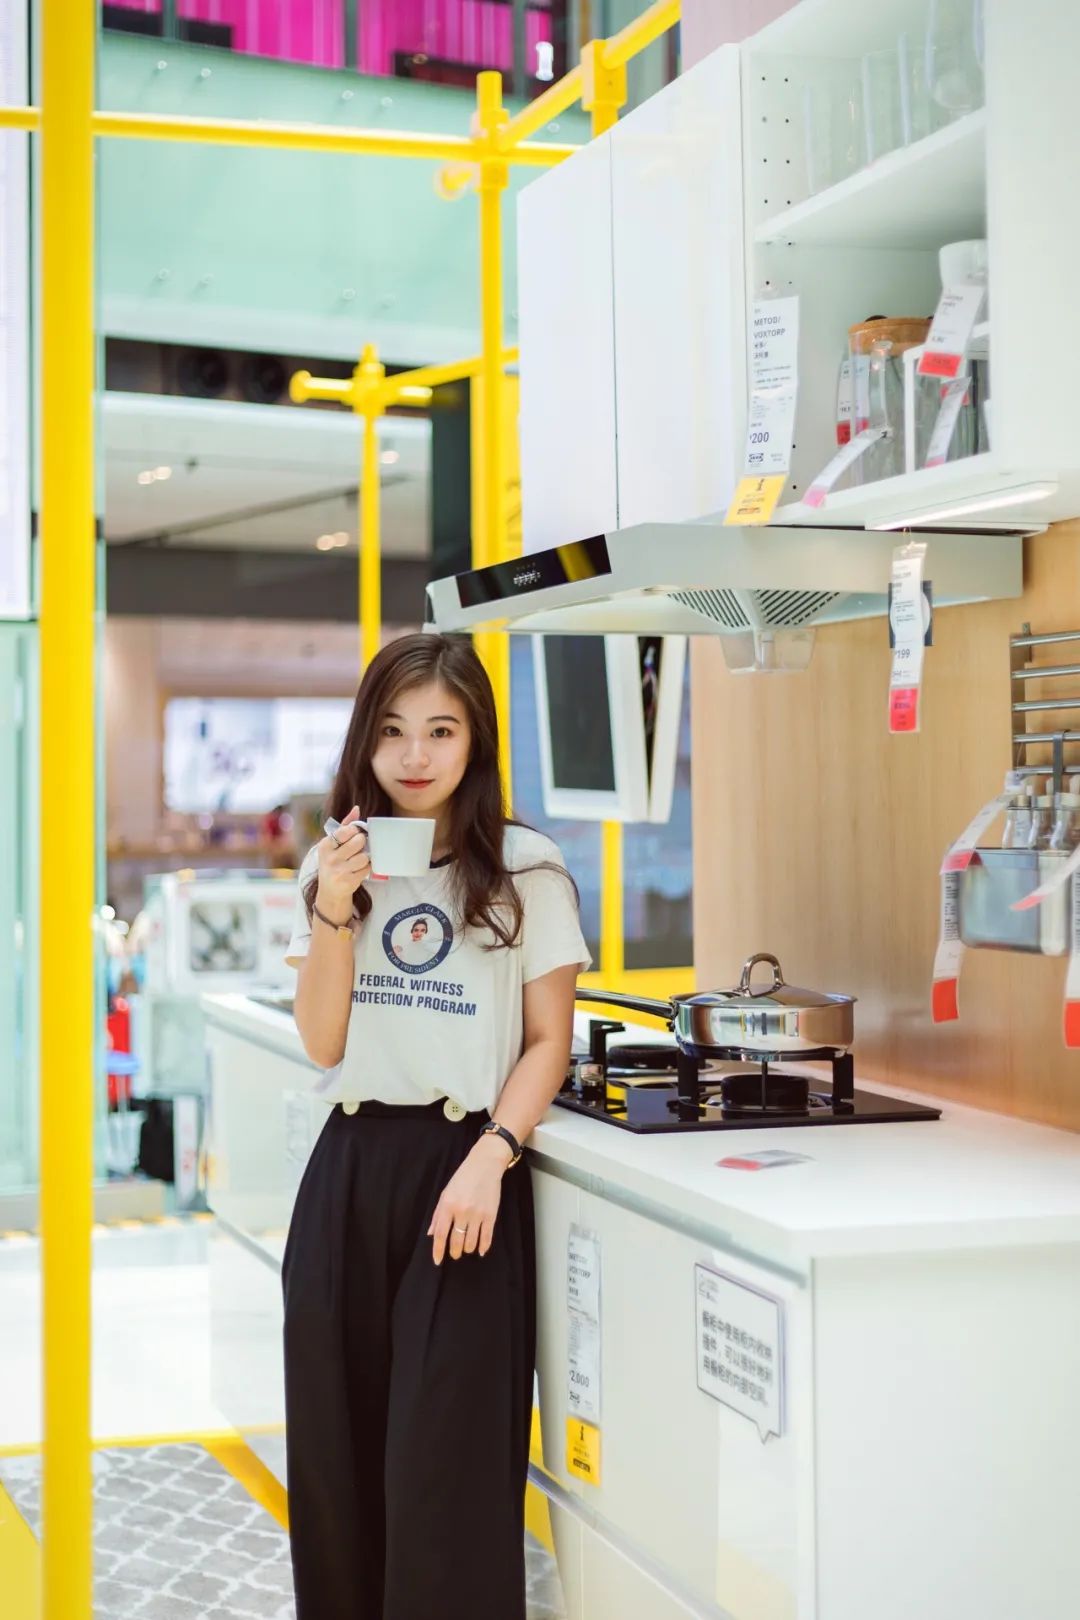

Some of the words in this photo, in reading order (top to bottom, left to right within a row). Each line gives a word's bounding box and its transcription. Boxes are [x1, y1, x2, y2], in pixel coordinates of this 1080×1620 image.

[753, 328, 786, 339] VOXTORP
[400, 957, 440, 974] PRESIDENT
[360, 974, 405, 989] FEDERAL
[410, 978, 464, 997] WITNESS
[352, 990, 413, 1007] ROTECTION
[416, 996, 477, 1016] PROGRAM
